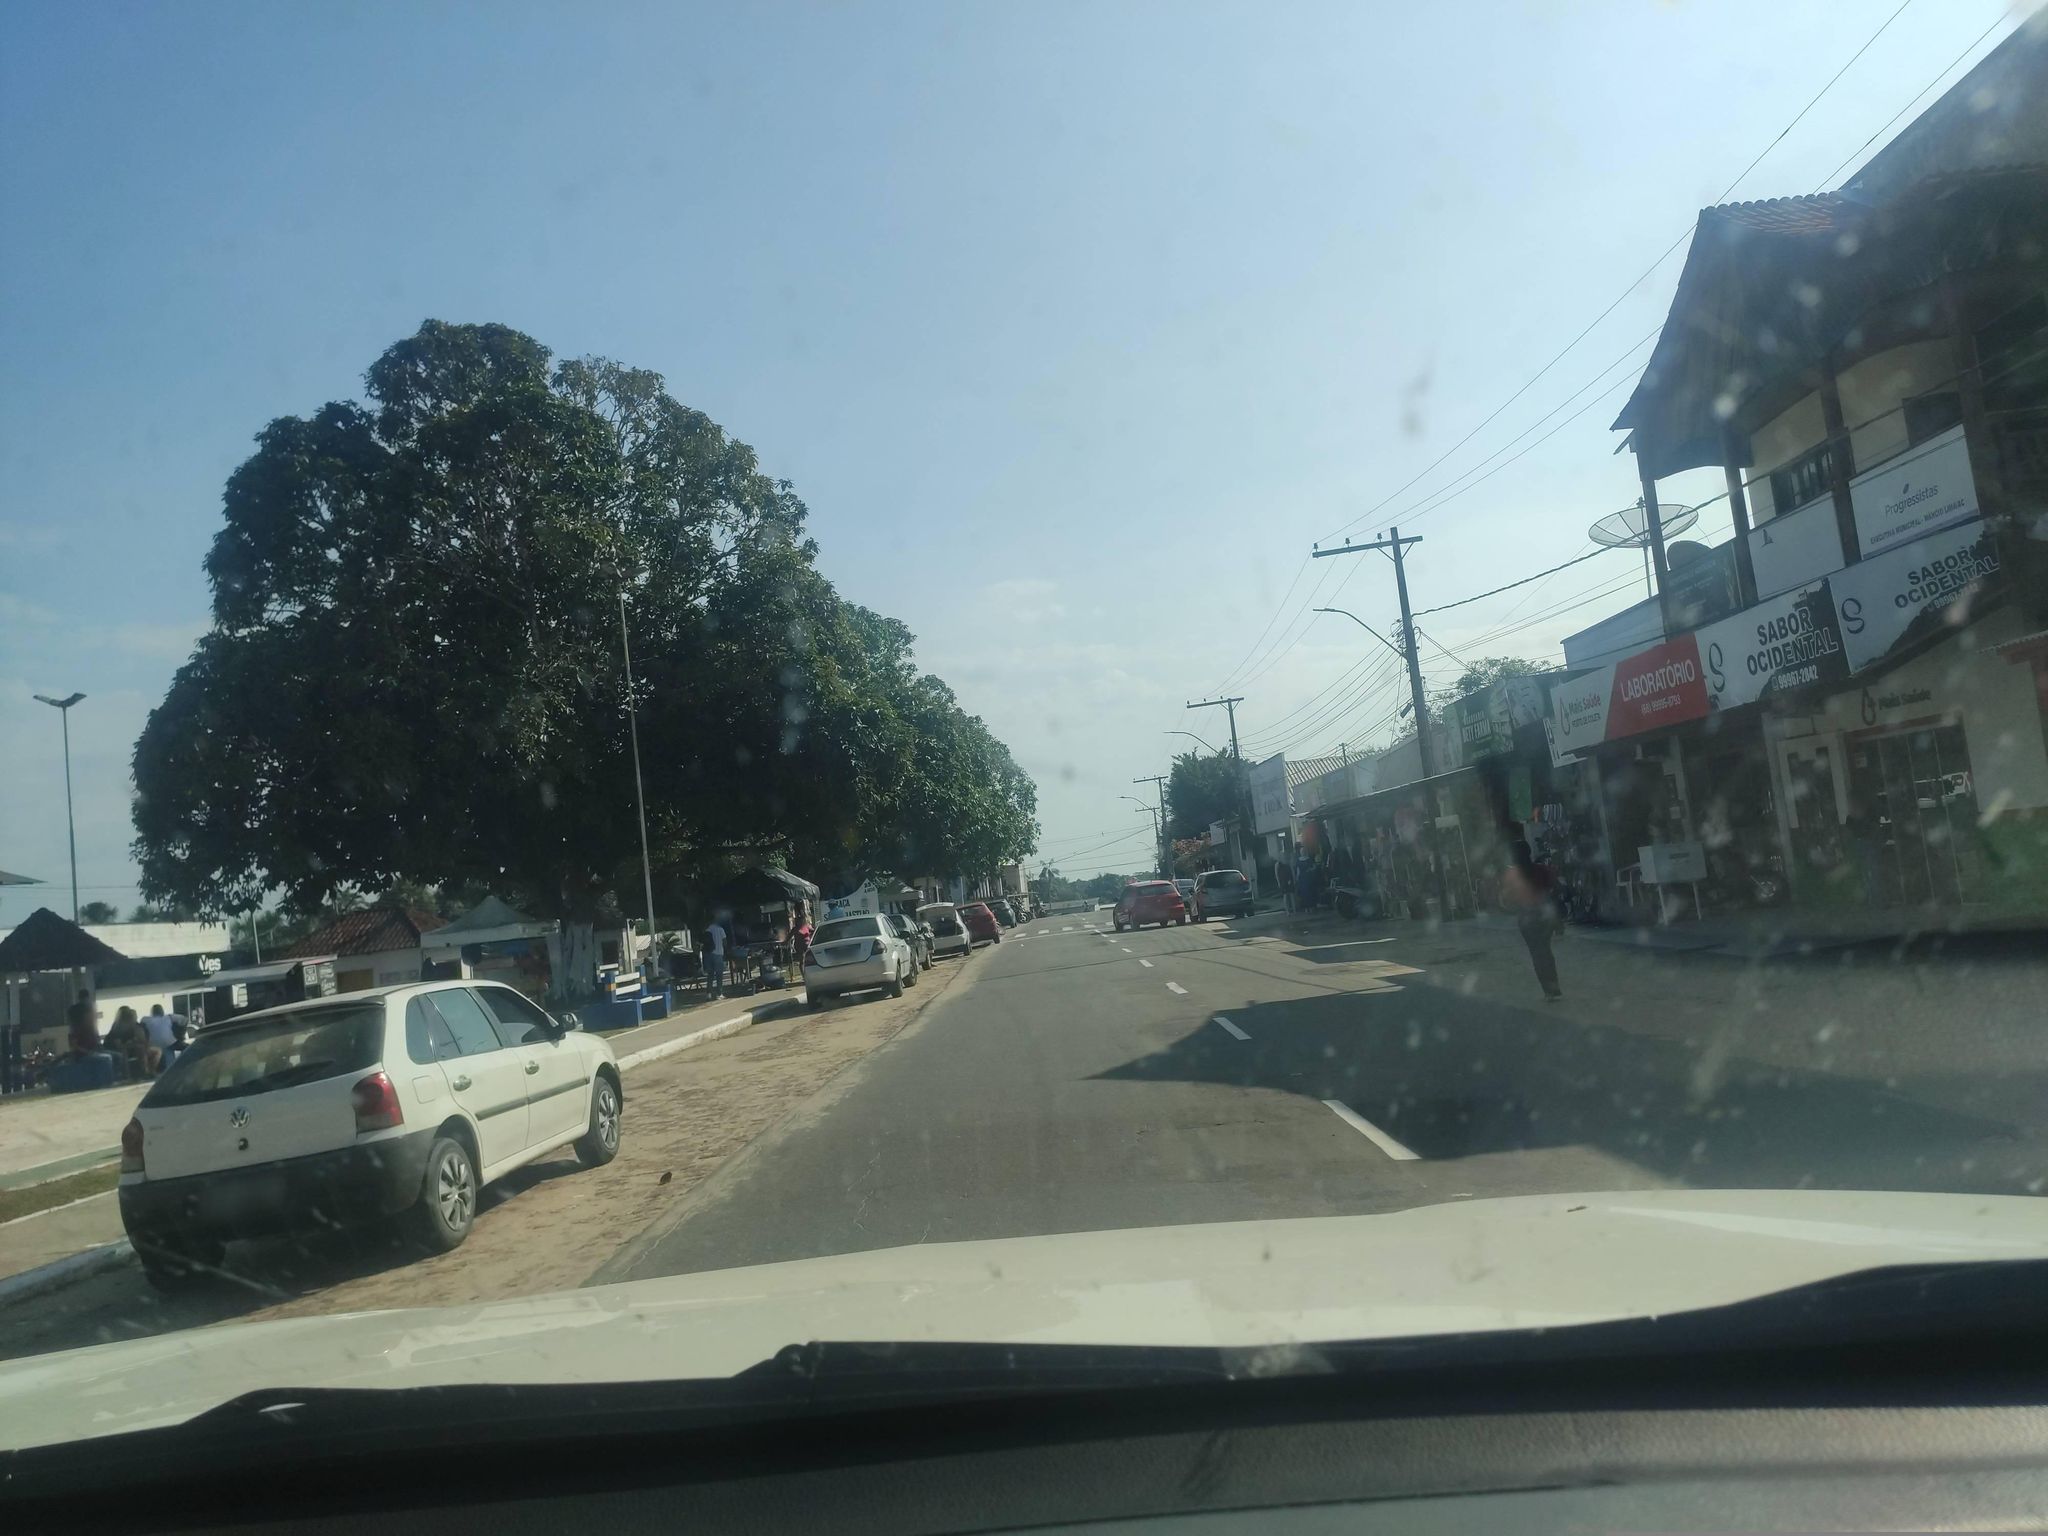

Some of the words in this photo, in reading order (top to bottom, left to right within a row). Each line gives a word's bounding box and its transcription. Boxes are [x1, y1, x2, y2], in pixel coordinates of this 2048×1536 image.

[1885, 484, 1939, 519] Progressistas
[1894, 556, 2000, 609] OCIDENTAL
[1907, 547, 1975, 586] SABOR
[1757, 606, 1814, 647] SABOR
[1746, 627, 1840, 676] OCIDENTAL
[1620, 658, 1696, 703] LABORATÓRIO
[1568, 698, 1583, 716] Mais
[1582, 689, 1602, 711] Saúde
